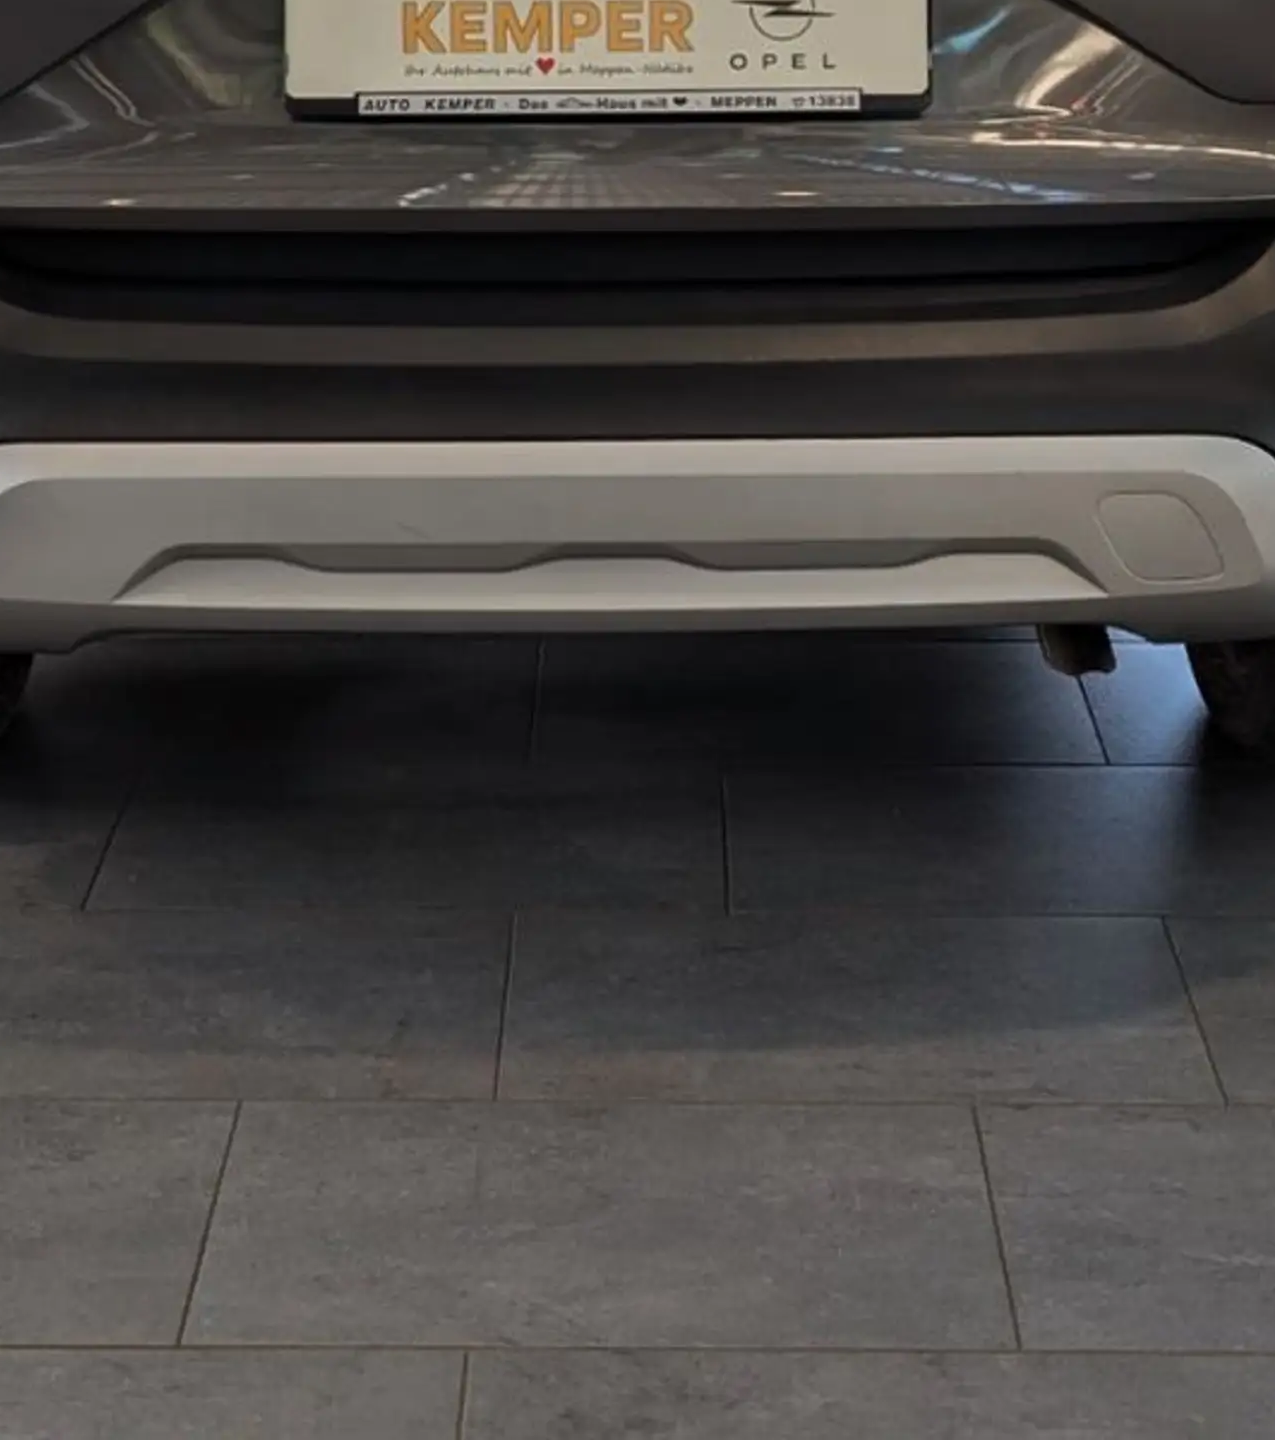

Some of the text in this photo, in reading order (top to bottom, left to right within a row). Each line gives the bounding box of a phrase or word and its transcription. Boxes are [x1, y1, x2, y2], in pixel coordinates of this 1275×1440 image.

[729, 53, 837, 71] OPEL
[363, 98, 411, 111] AUTO
[424, 98, 496, 110] KEMPER
[518, 98, 548, 109] Das
[641, 97, 667, 108] mit
[710, 96, 778, 108] MEPPEN
